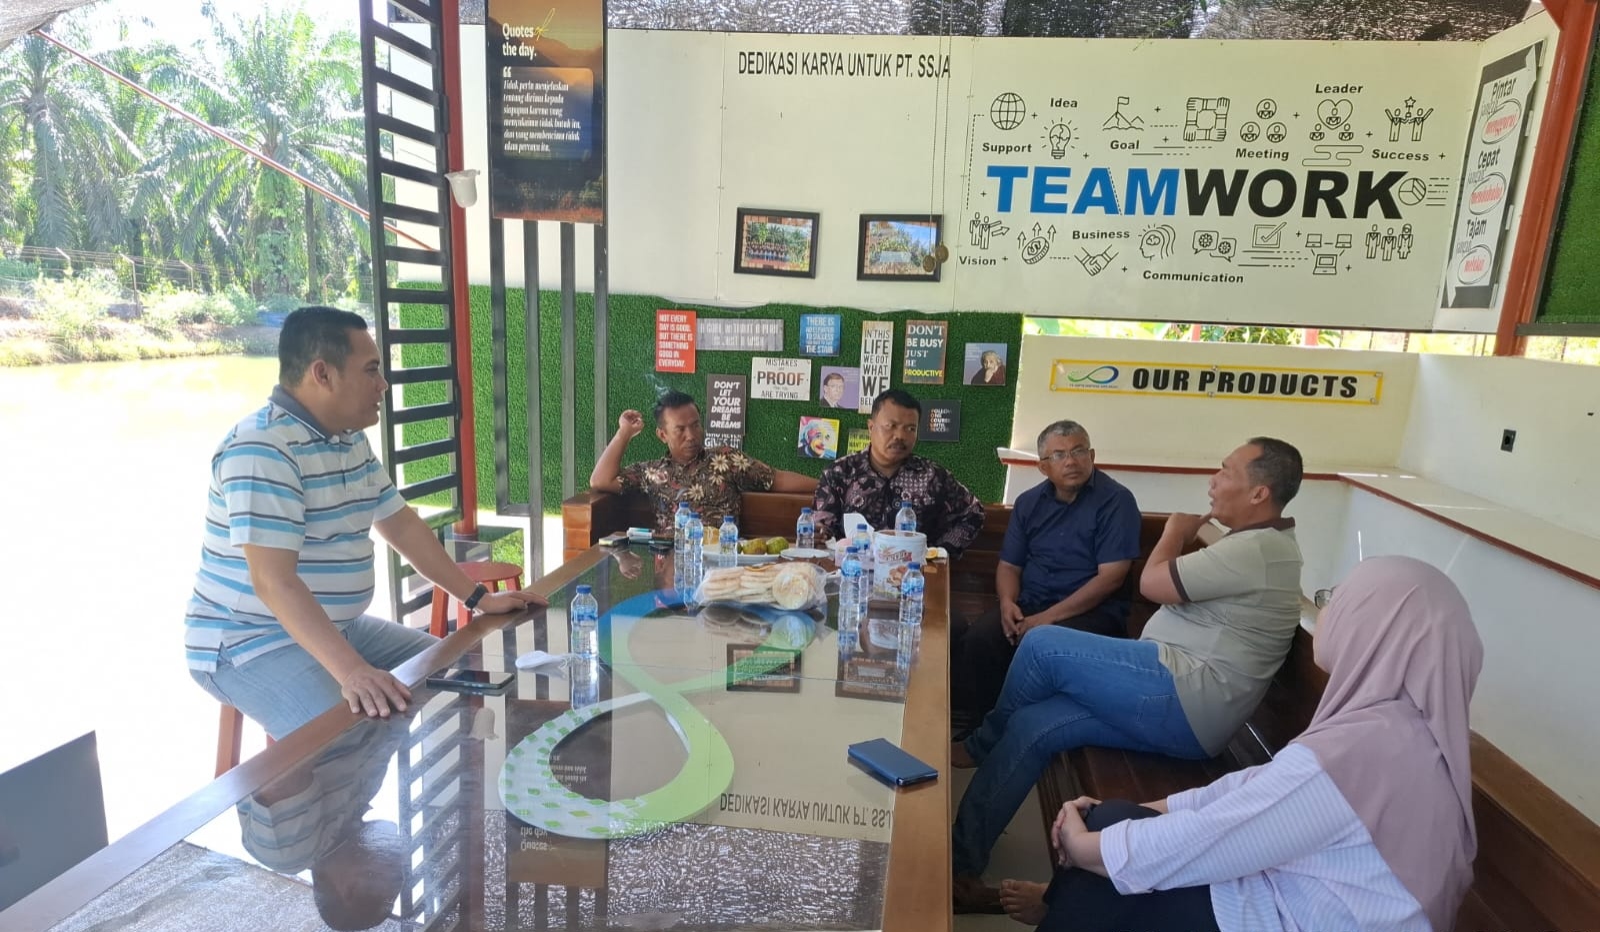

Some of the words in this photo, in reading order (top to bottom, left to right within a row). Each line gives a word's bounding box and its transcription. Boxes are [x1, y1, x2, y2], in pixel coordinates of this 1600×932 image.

[502, 22, 534, 40] Quotes
[502, 42, 517, 56] the
[518, 44, 537, 61] day.
[738, 51, 798, 75] DEDIKASI
[801, 52, 844, 77] KARYA
[848, 53, 892, 77] UNTUK
[896, 54, 914, 78] PT.
[918, 54, 952, 79] SSJA
[1315, 83, 1364, 95] Leader
[1492, 78, 1516, 99] Pintar
[1050, 97, 1078, 109] Idea
[982, 142, 1033, 156] Support
[1110, 140, 1140, 150] Goal
[1235, 148, 1290, 162] Meeting
[1372, 148, 1430, 162] Success
[1478, 148, 1501, 171] Cepat
[987, 165, 1409, 220] TEAMWORK
[1466, 218, 1487, 239] Tajam
[1072, 229, 1131, 241] Business
[958, 255, 997, 268] Vision
[1142, 269, 1245, 285] Communication
[659, 314, 670, 323] NOT
[670, 314, 688, 324] EVERY
[806, 316, 827, 326] THERE
[828, 316, 834, 326] IS
[659, 322, 670, 332] DAY
[670, 324, 675, 332] IS
[907, 325, 945, 336] DON'T
[659, 332, 669, 340] BUT
[670, 332, 688, 342] THERE
[688, 333, 694, 342] IS
[864, 330, 872, 339] IN
[874, 330, 890, 339] THIS
[659, 341, 689, 350] SOMETHING
[864, 339, 888, 355] LIFE
[906, 338, 918, 347] BE
[920, 338, 944, 348] BUSY
[658, 350, 673, 358] GOOD
[806, 345, 816, 354] THE
[906, 350, 928, 358] JUST
[766, 358, 798, 368] MISTAKES
[864, 354, 874, 363] WE
[876, 355, 888, 364] GOT
[906, 359, 917, 367] BE
[863, 364, 888, 376] WHAT
[904, 369, 943, 377] PRODUCTIVE
[757, 370, 805, 386] PROOF
[1133, 368, 1190, 391] OUR
[1198, 370, 1358, 398] PRODUCTS
[714, 381, 740, 389] DON'T
[862, 376, 888, 397] WE
[761, 390, 773, 398] ARE
[775, 390, 798, 400] TRYING
[714, 397, 741, 406] YOUR
[711, 406, 741, 414] DREAMS
[710, 420, 741, 429] DREAMS
